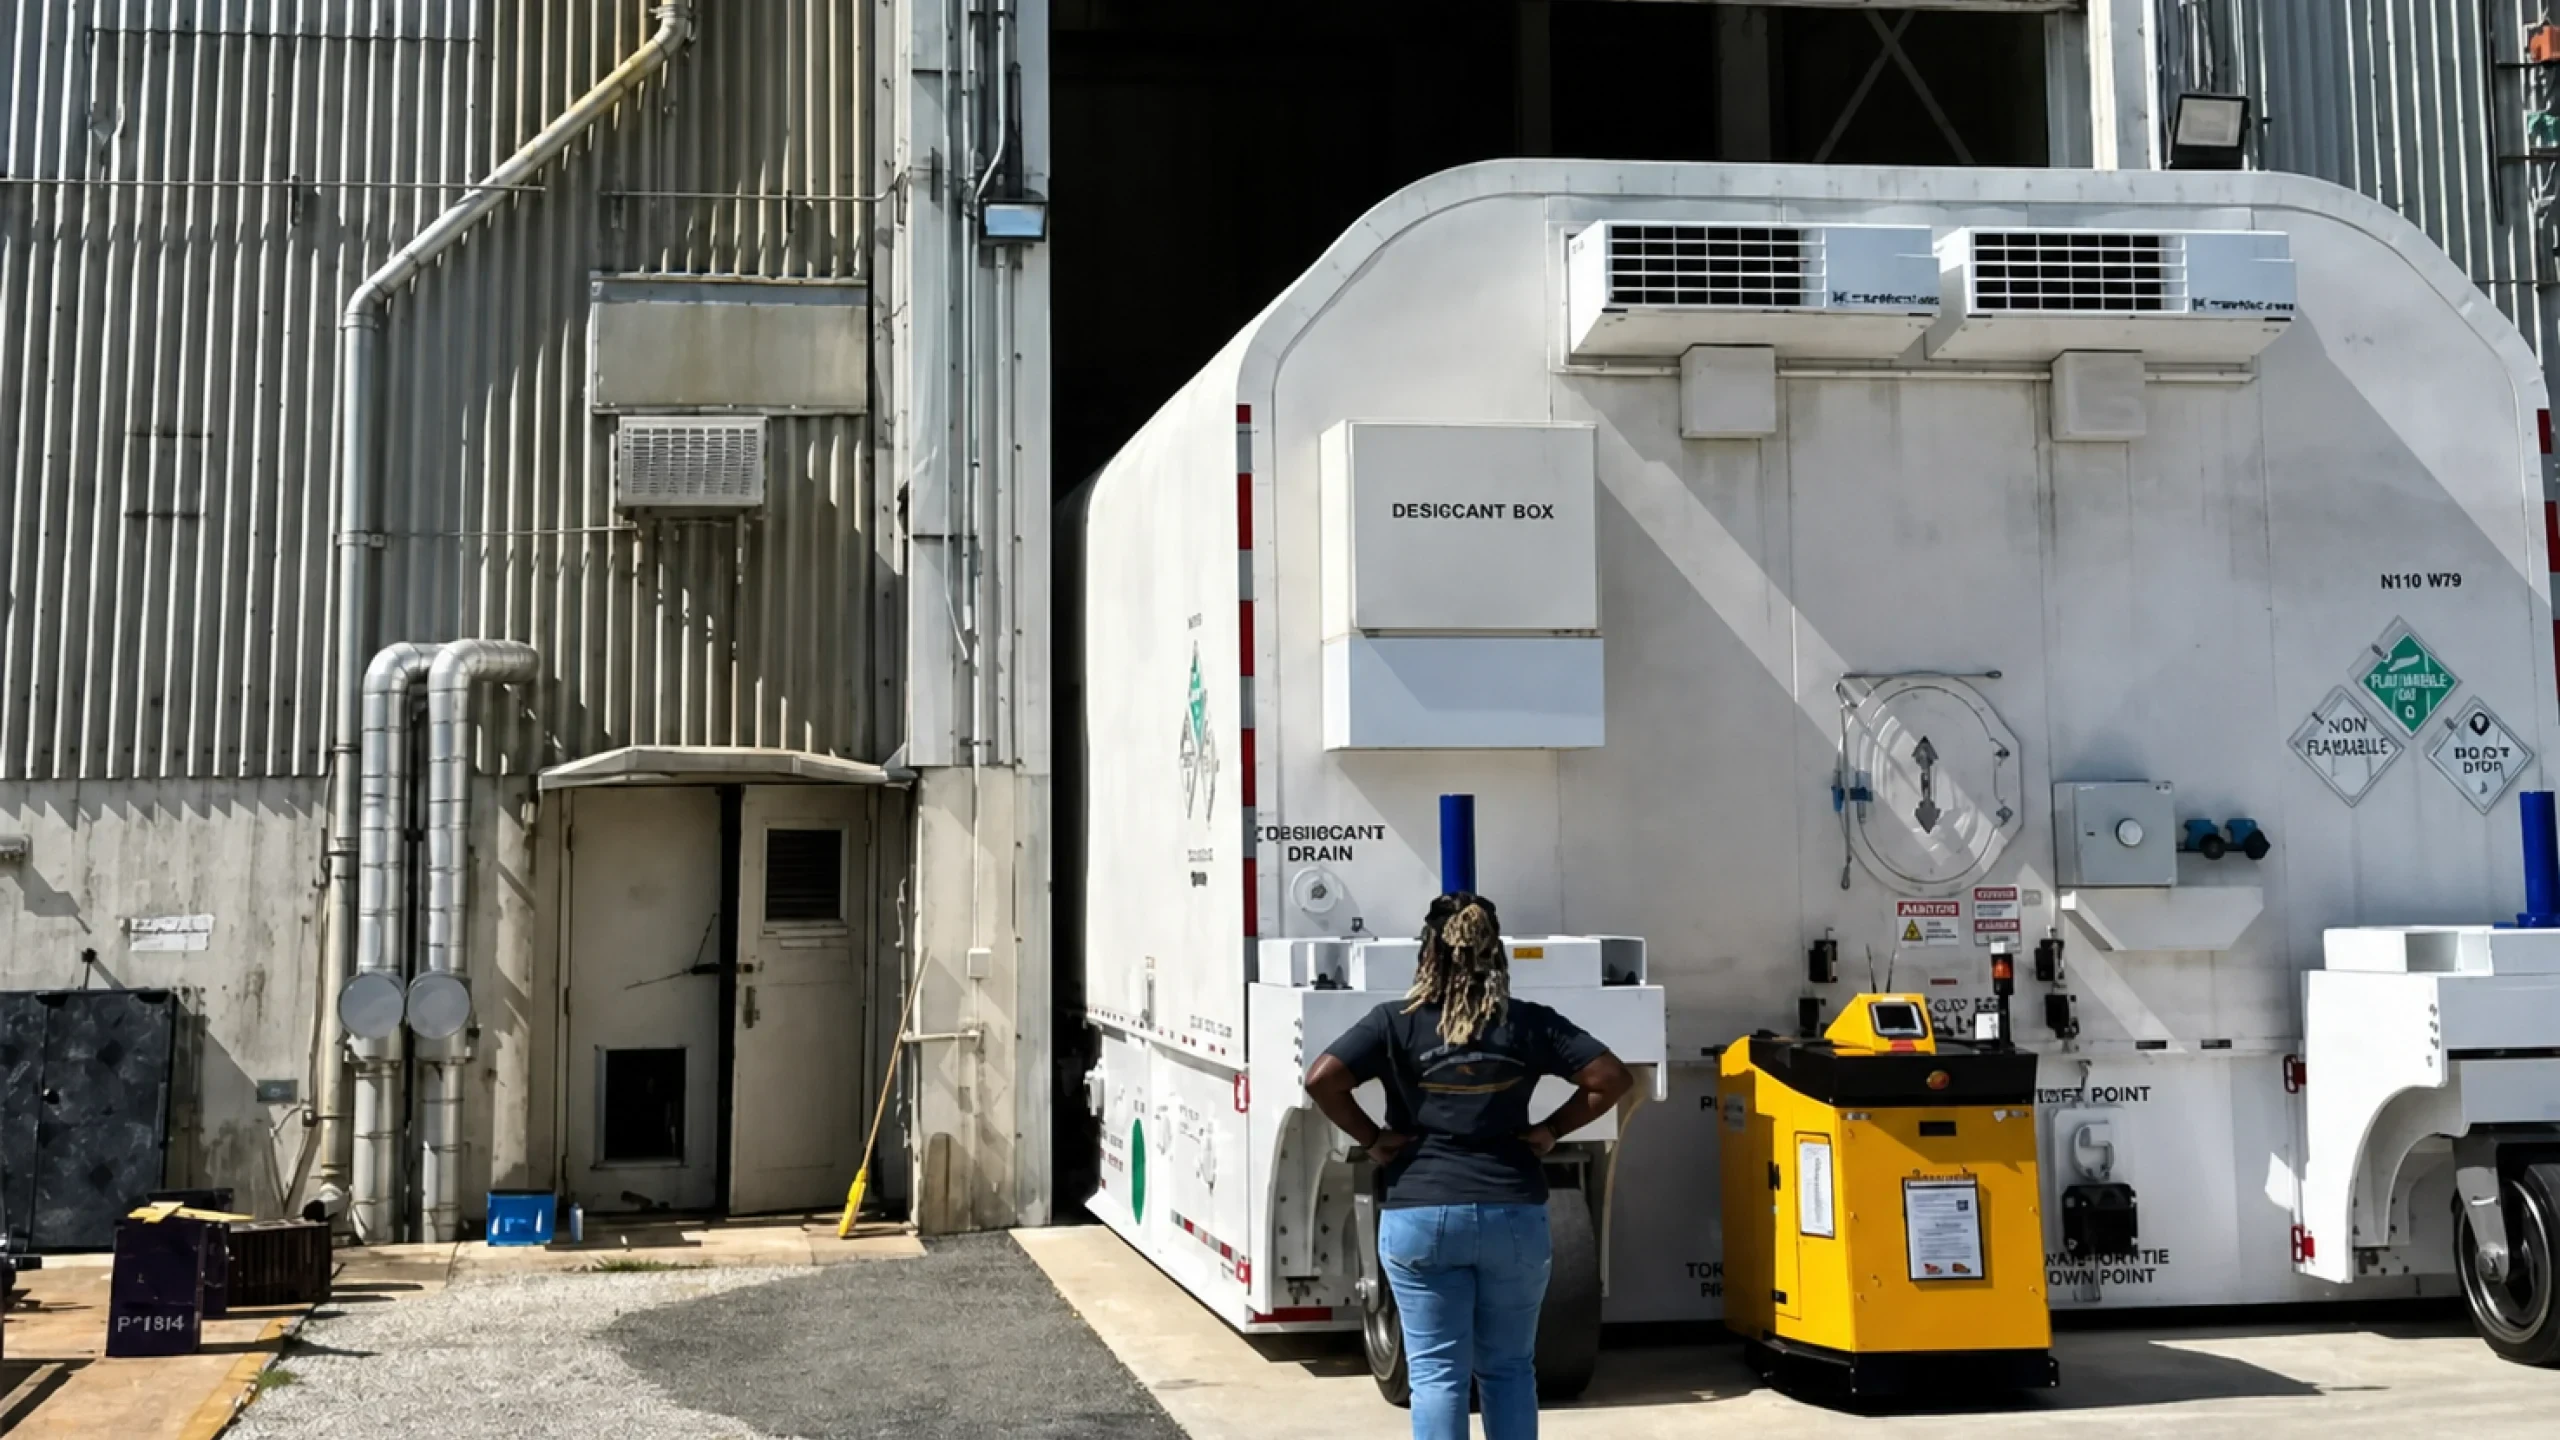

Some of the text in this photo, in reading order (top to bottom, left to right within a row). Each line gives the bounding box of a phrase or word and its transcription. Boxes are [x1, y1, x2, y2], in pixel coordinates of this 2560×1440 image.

[1513, 503, 1554, 519] BOX
[2381, 573, 2462, 589] N110 W79
[2328, 717, 2368, 734] NON
[1288, 846, 1352, 861] DRAIN
[2091, 1086, 2151, 1102] POINT
[2142, 1250, 2169, 1264] TIE
[2101, 1268, 2156, 1285] POINT
